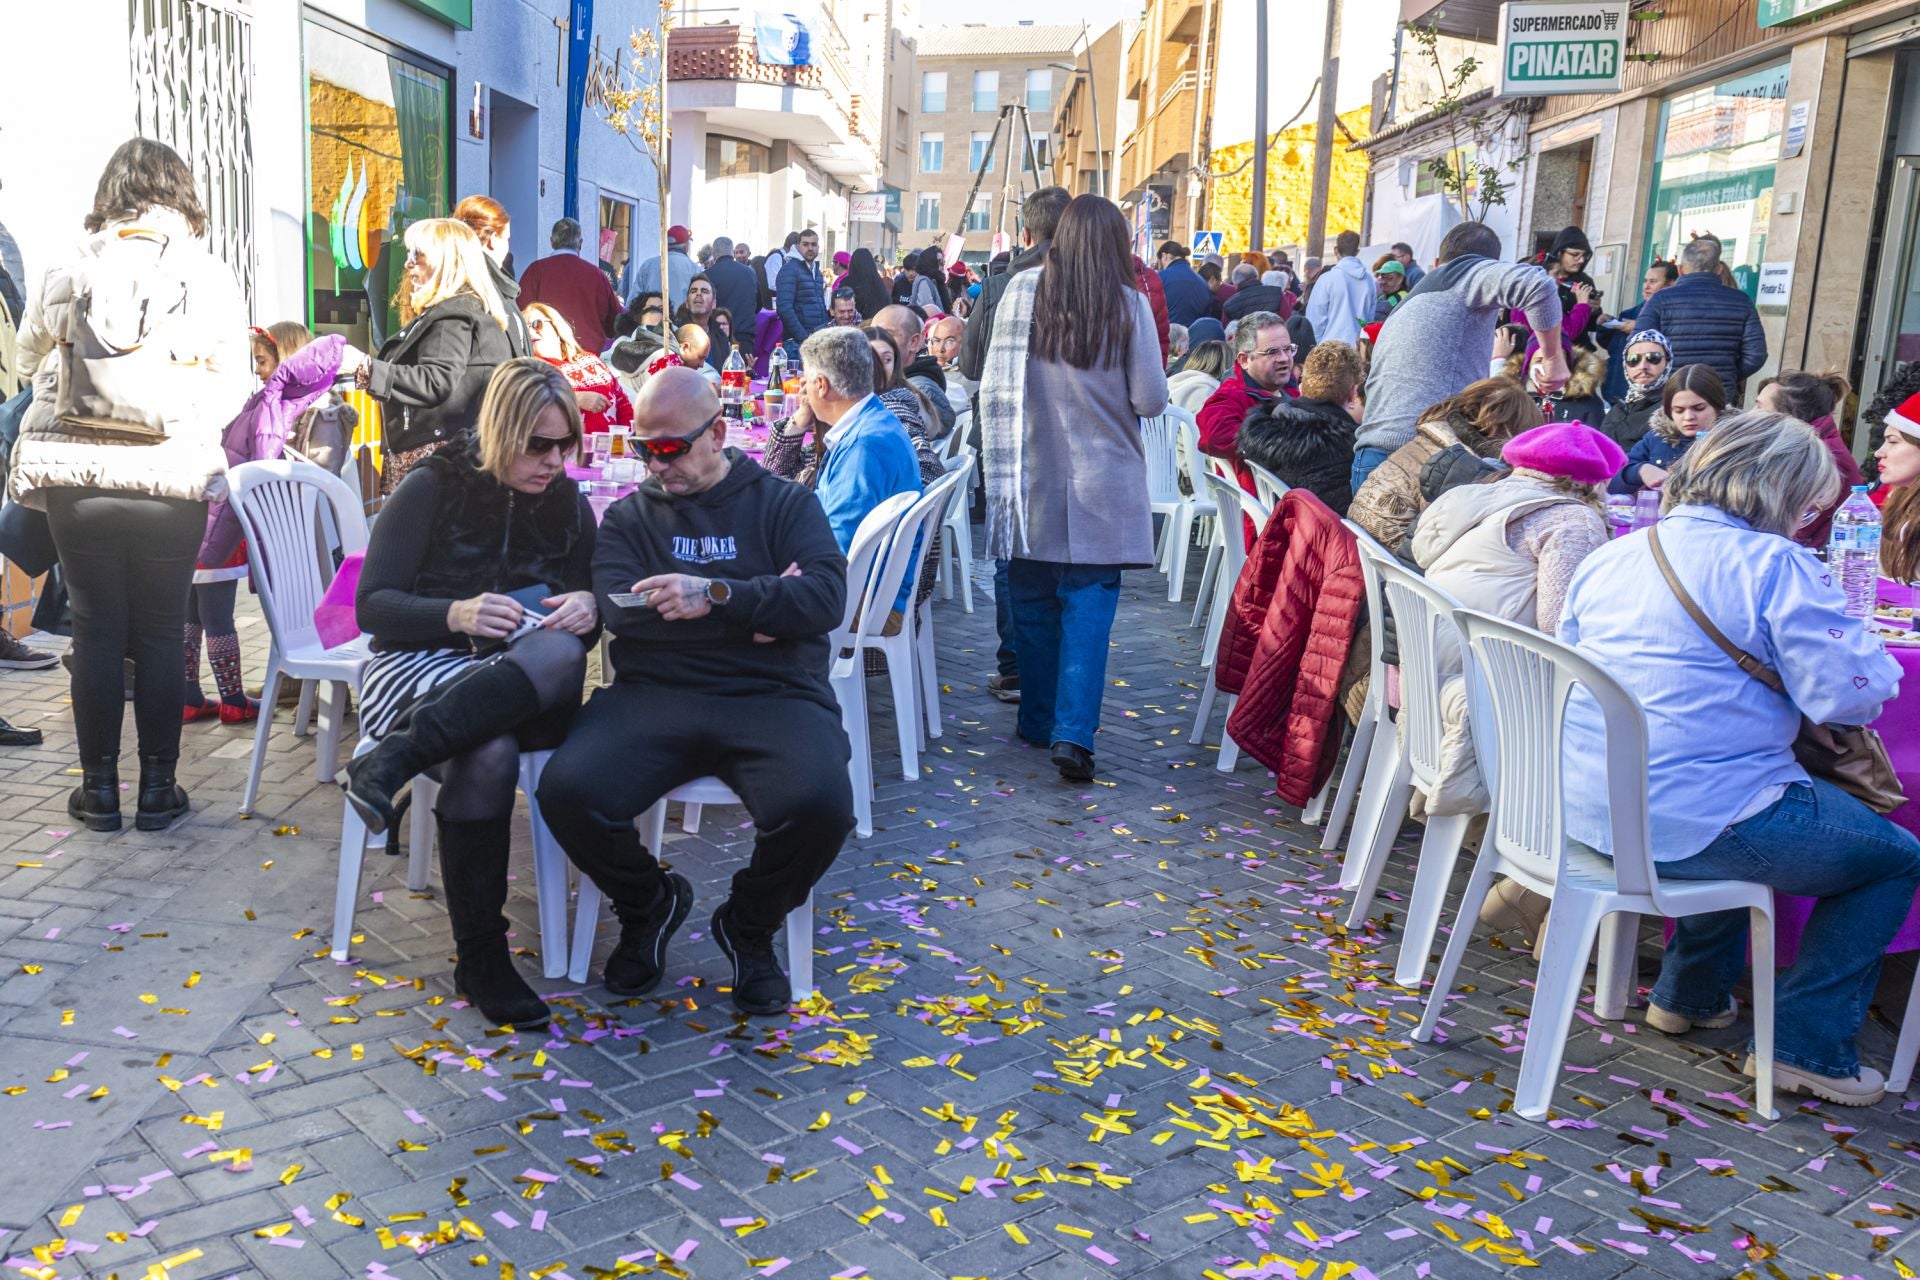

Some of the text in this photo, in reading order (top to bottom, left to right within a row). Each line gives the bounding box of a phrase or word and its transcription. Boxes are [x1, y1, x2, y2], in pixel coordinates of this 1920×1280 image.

[1512, 15, 1601, 32] SUPERMERCADO
[1511, 43, 1615, 77] PINATAR
[1720, 181, 1753, 202] FRÍAS
[673, 536, 736, 556] THE JOKER
